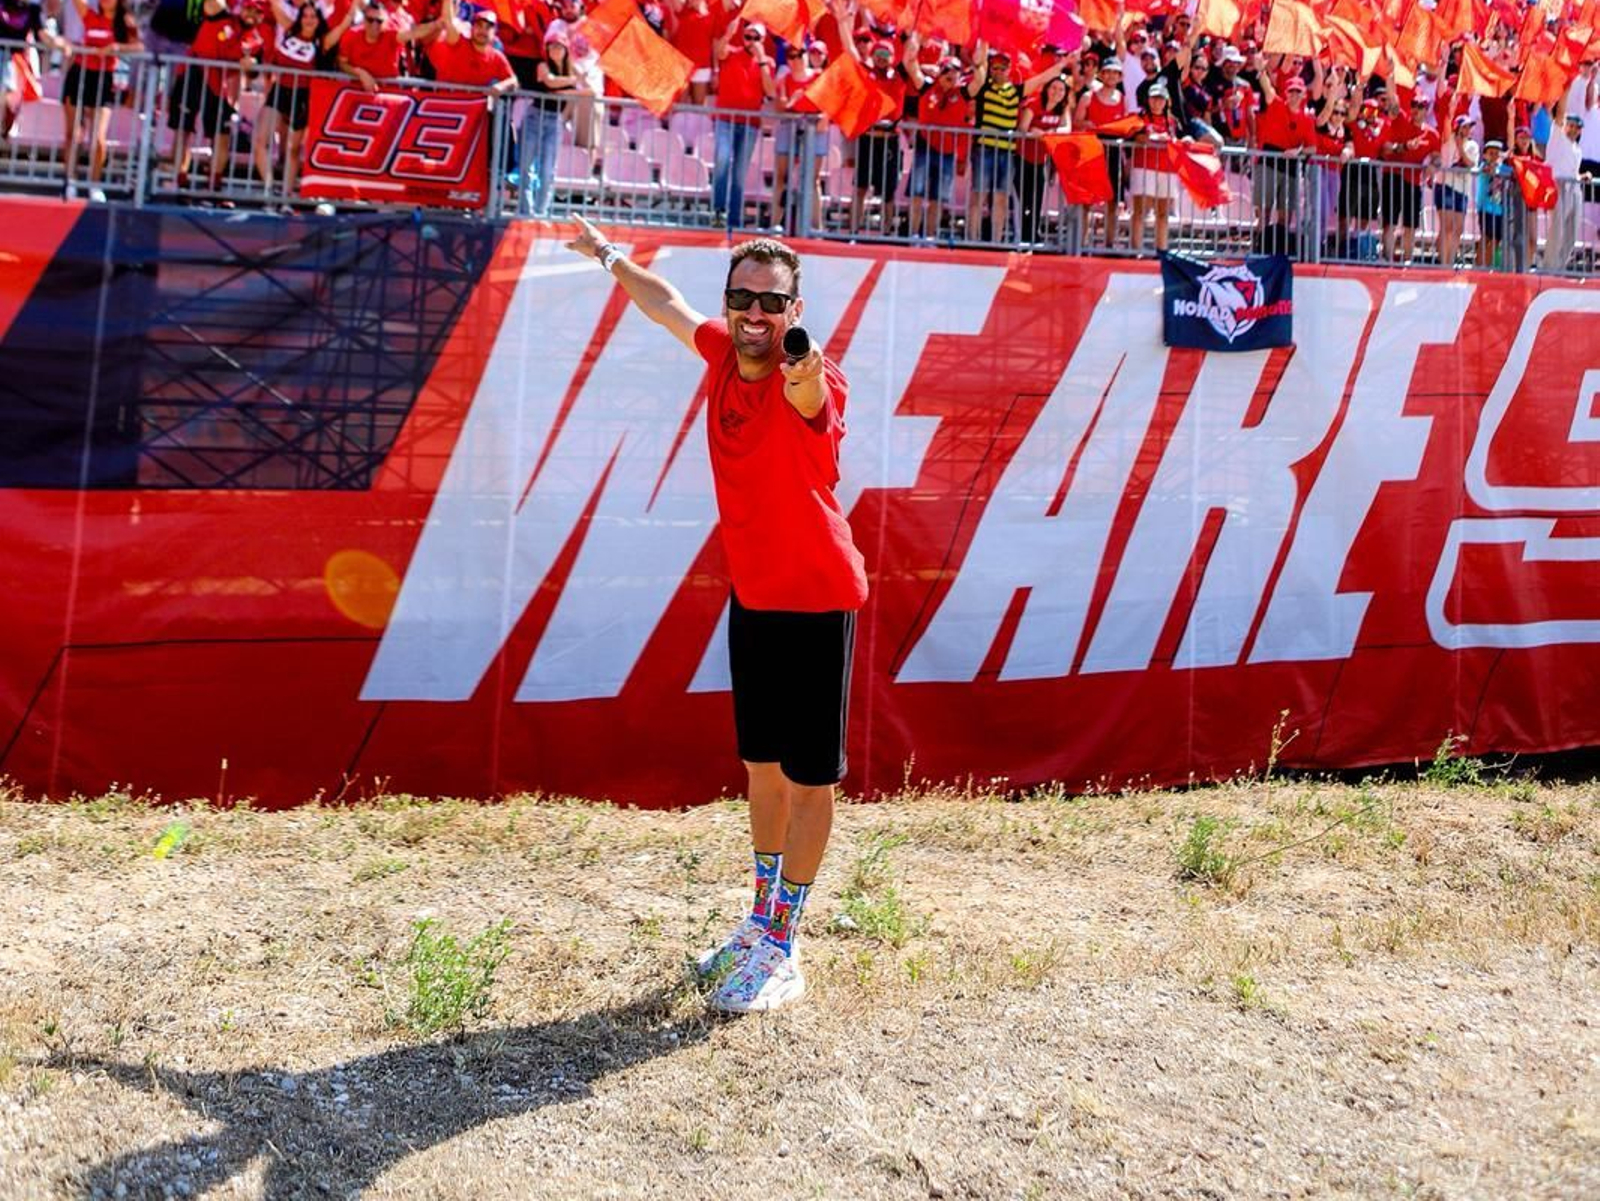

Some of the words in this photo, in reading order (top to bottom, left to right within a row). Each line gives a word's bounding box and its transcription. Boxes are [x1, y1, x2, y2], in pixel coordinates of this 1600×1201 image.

[281, 37, 316, 63] 93
[311, 89, 486, 182] 93
[893, 272, 1476, 683] ARE
